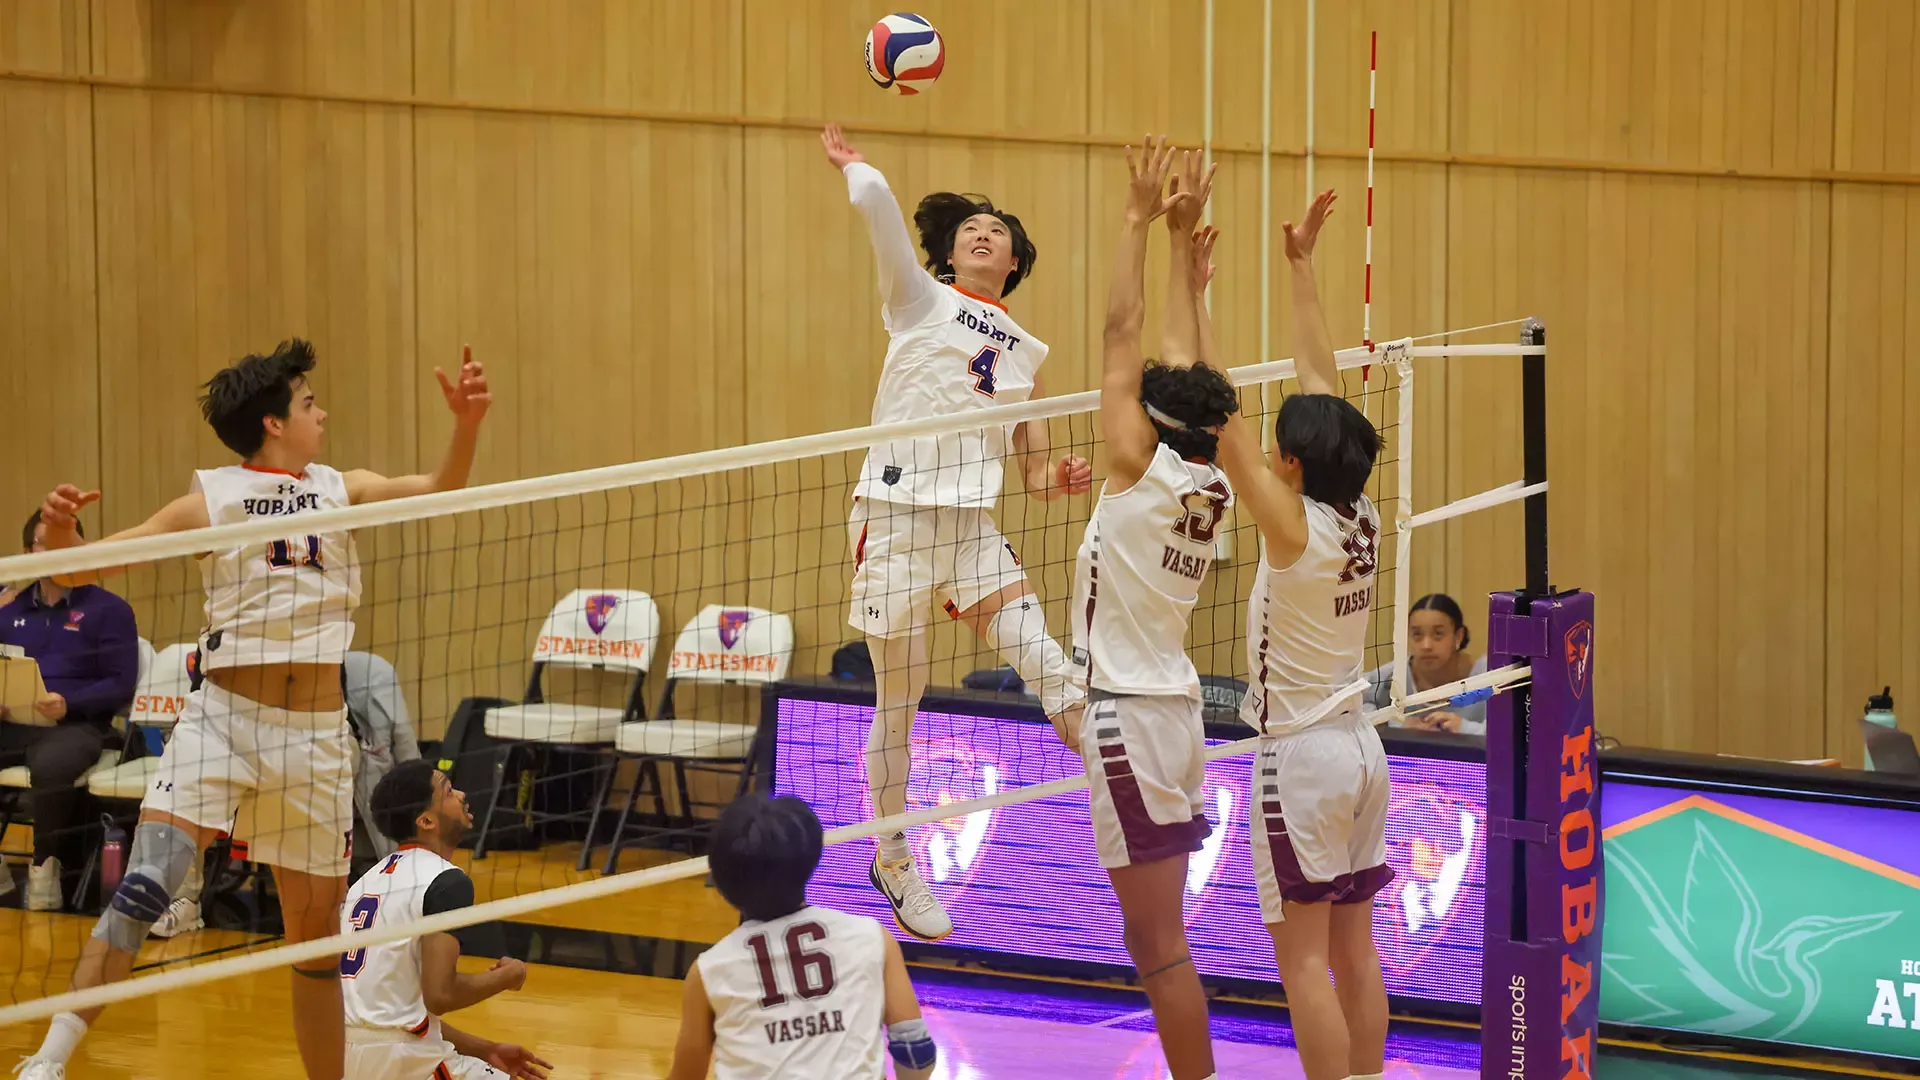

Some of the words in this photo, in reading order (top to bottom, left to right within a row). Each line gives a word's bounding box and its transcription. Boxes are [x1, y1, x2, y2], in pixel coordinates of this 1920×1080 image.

[956, 308, 1020, 351] HOBART
[968, 345, 1000, 399] 4
[243, 493, 319, 515] HOBART
[538, 636, 645, 659] STATESMEN
[670, 651, 778, 672] STATESMEN
[744, 919, 838, 1010] 16
[764, 1009, 846, 1045] VASSAR
[1508, 975, 1527, 1042] sports
